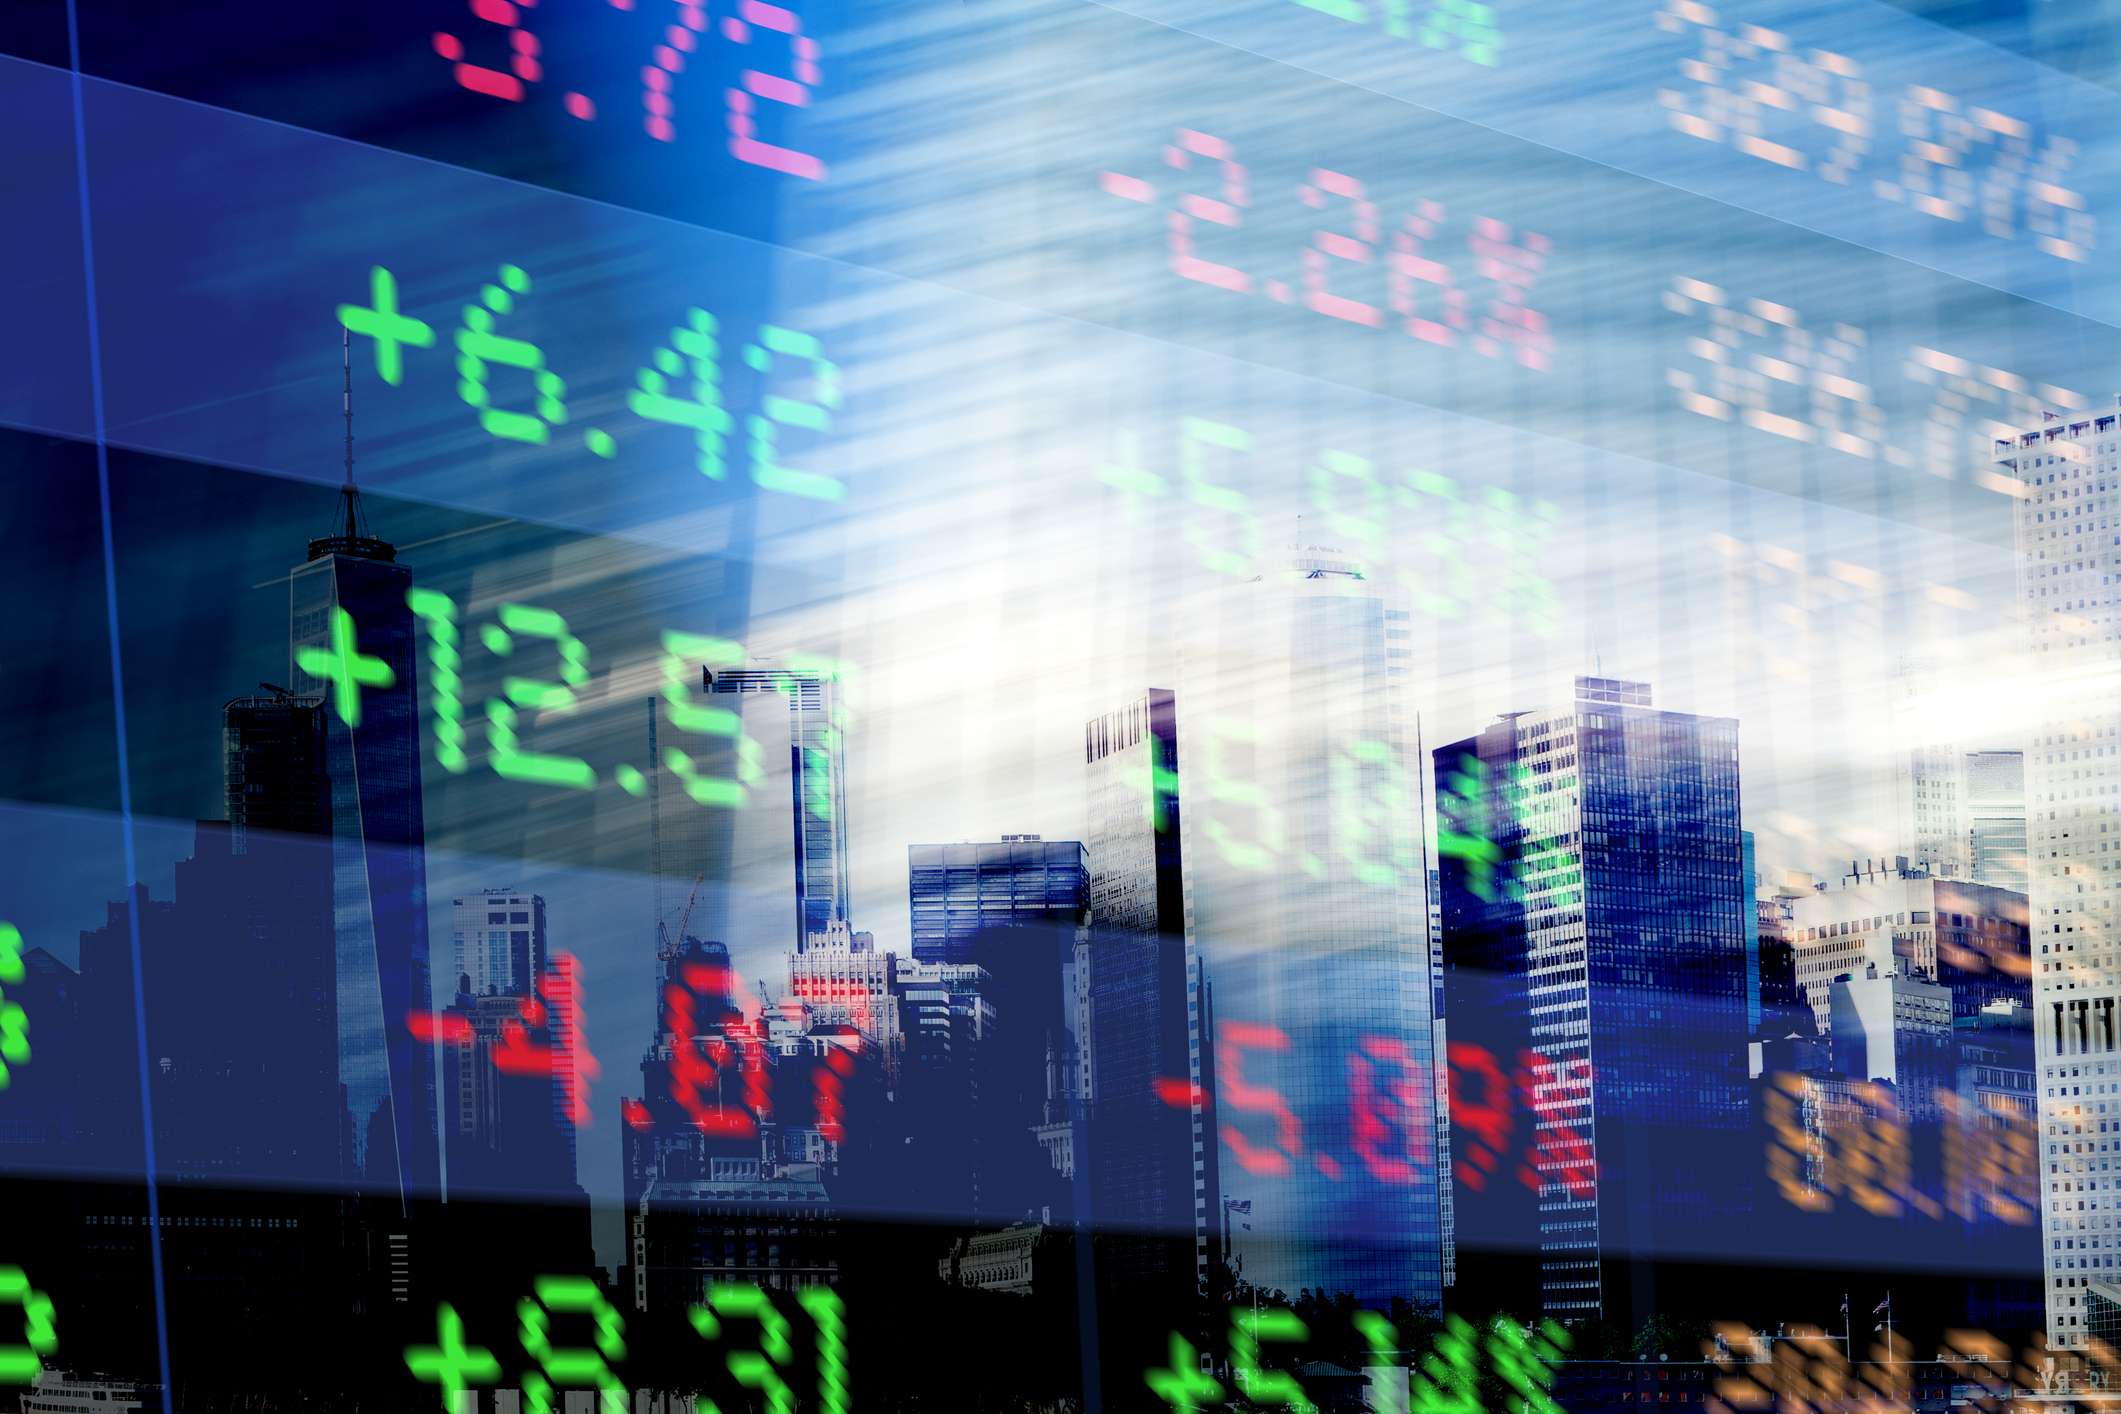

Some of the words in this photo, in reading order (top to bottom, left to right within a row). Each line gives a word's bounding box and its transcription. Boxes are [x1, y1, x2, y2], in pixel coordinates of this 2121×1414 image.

[1101, 128, 1556, 371] -2.26%
[336, 264, 847, 503] +6.42
[295, 587, 862, 822] +12.57
